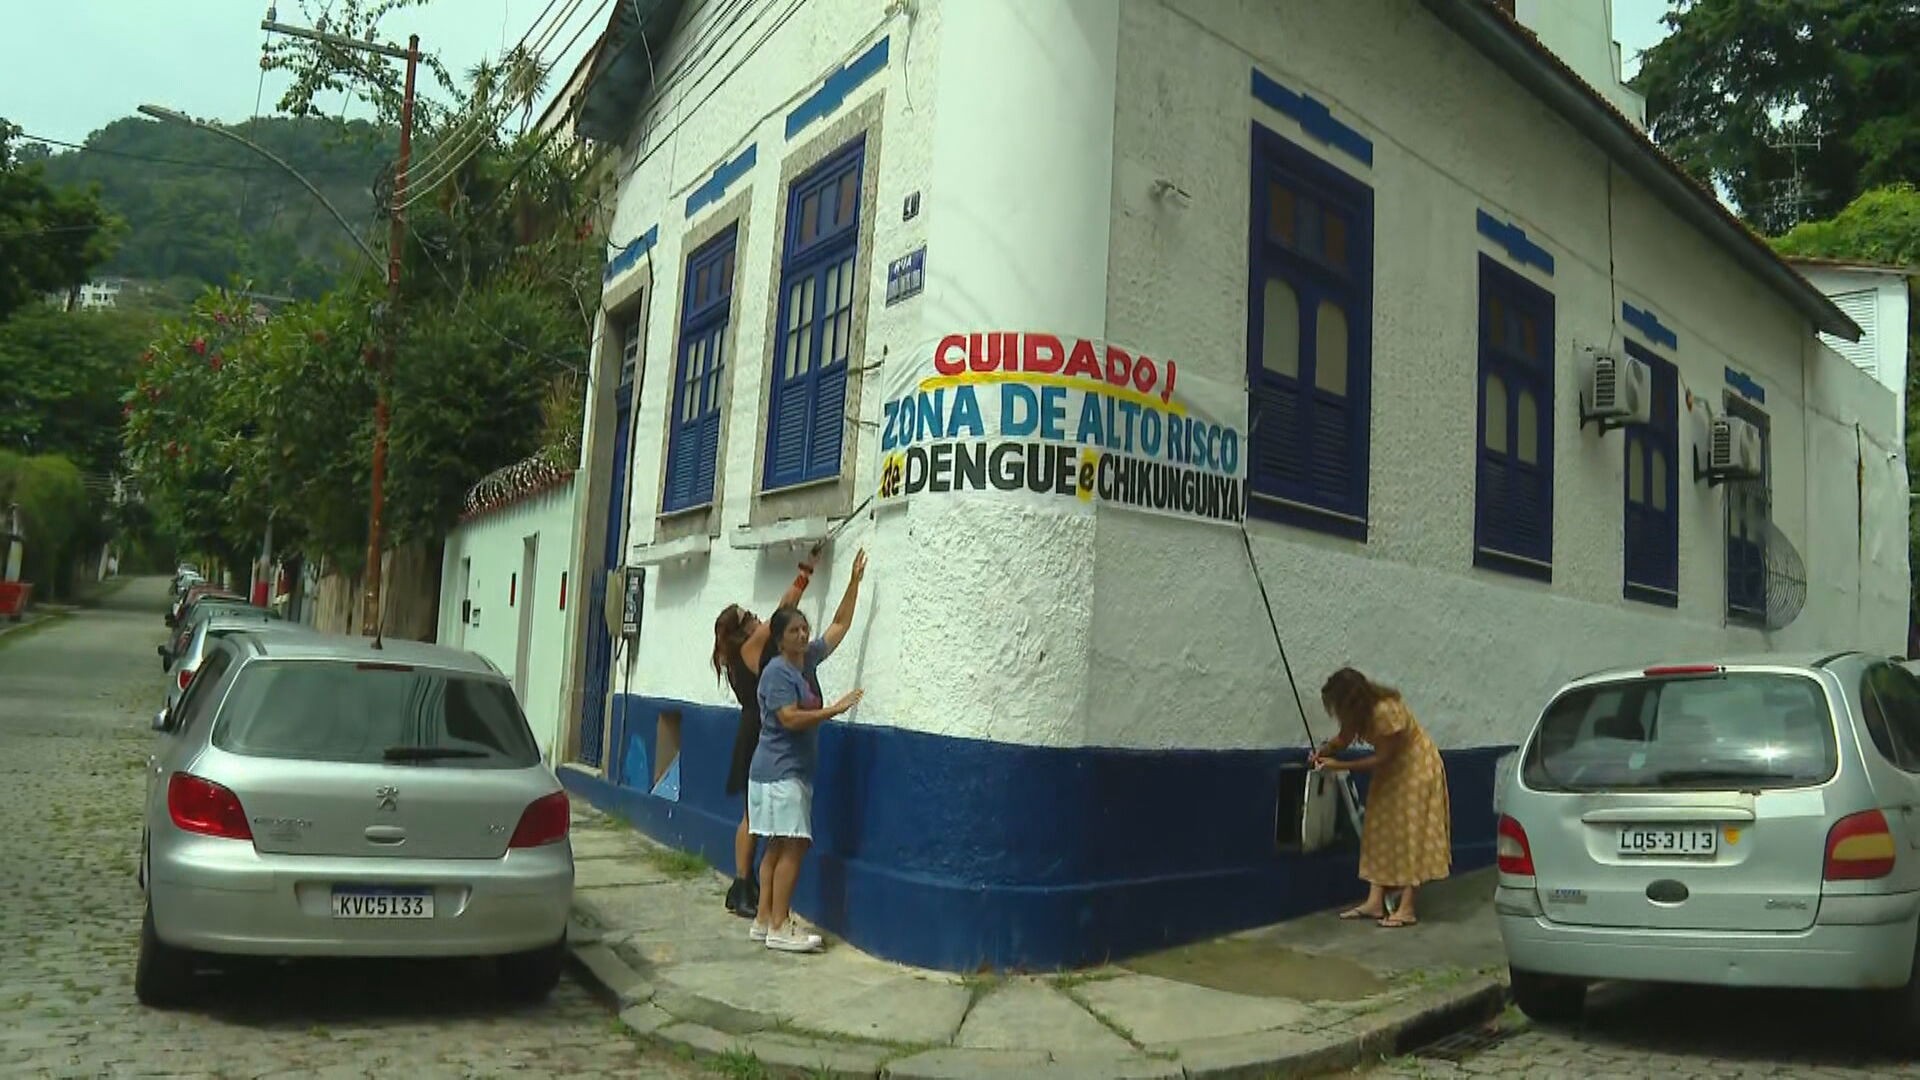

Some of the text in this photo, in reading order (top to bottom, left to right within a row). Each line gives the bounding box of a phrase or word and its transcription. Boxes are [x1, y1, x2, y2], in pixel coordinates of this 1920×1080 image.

[882, 383, 1238, 475] ZONA DE ALTO RISCO
[882, 443, 1248, 524] de DENGUE e CHIKUNGUNYA!
[341, 896, 423, 915] KVC5133
